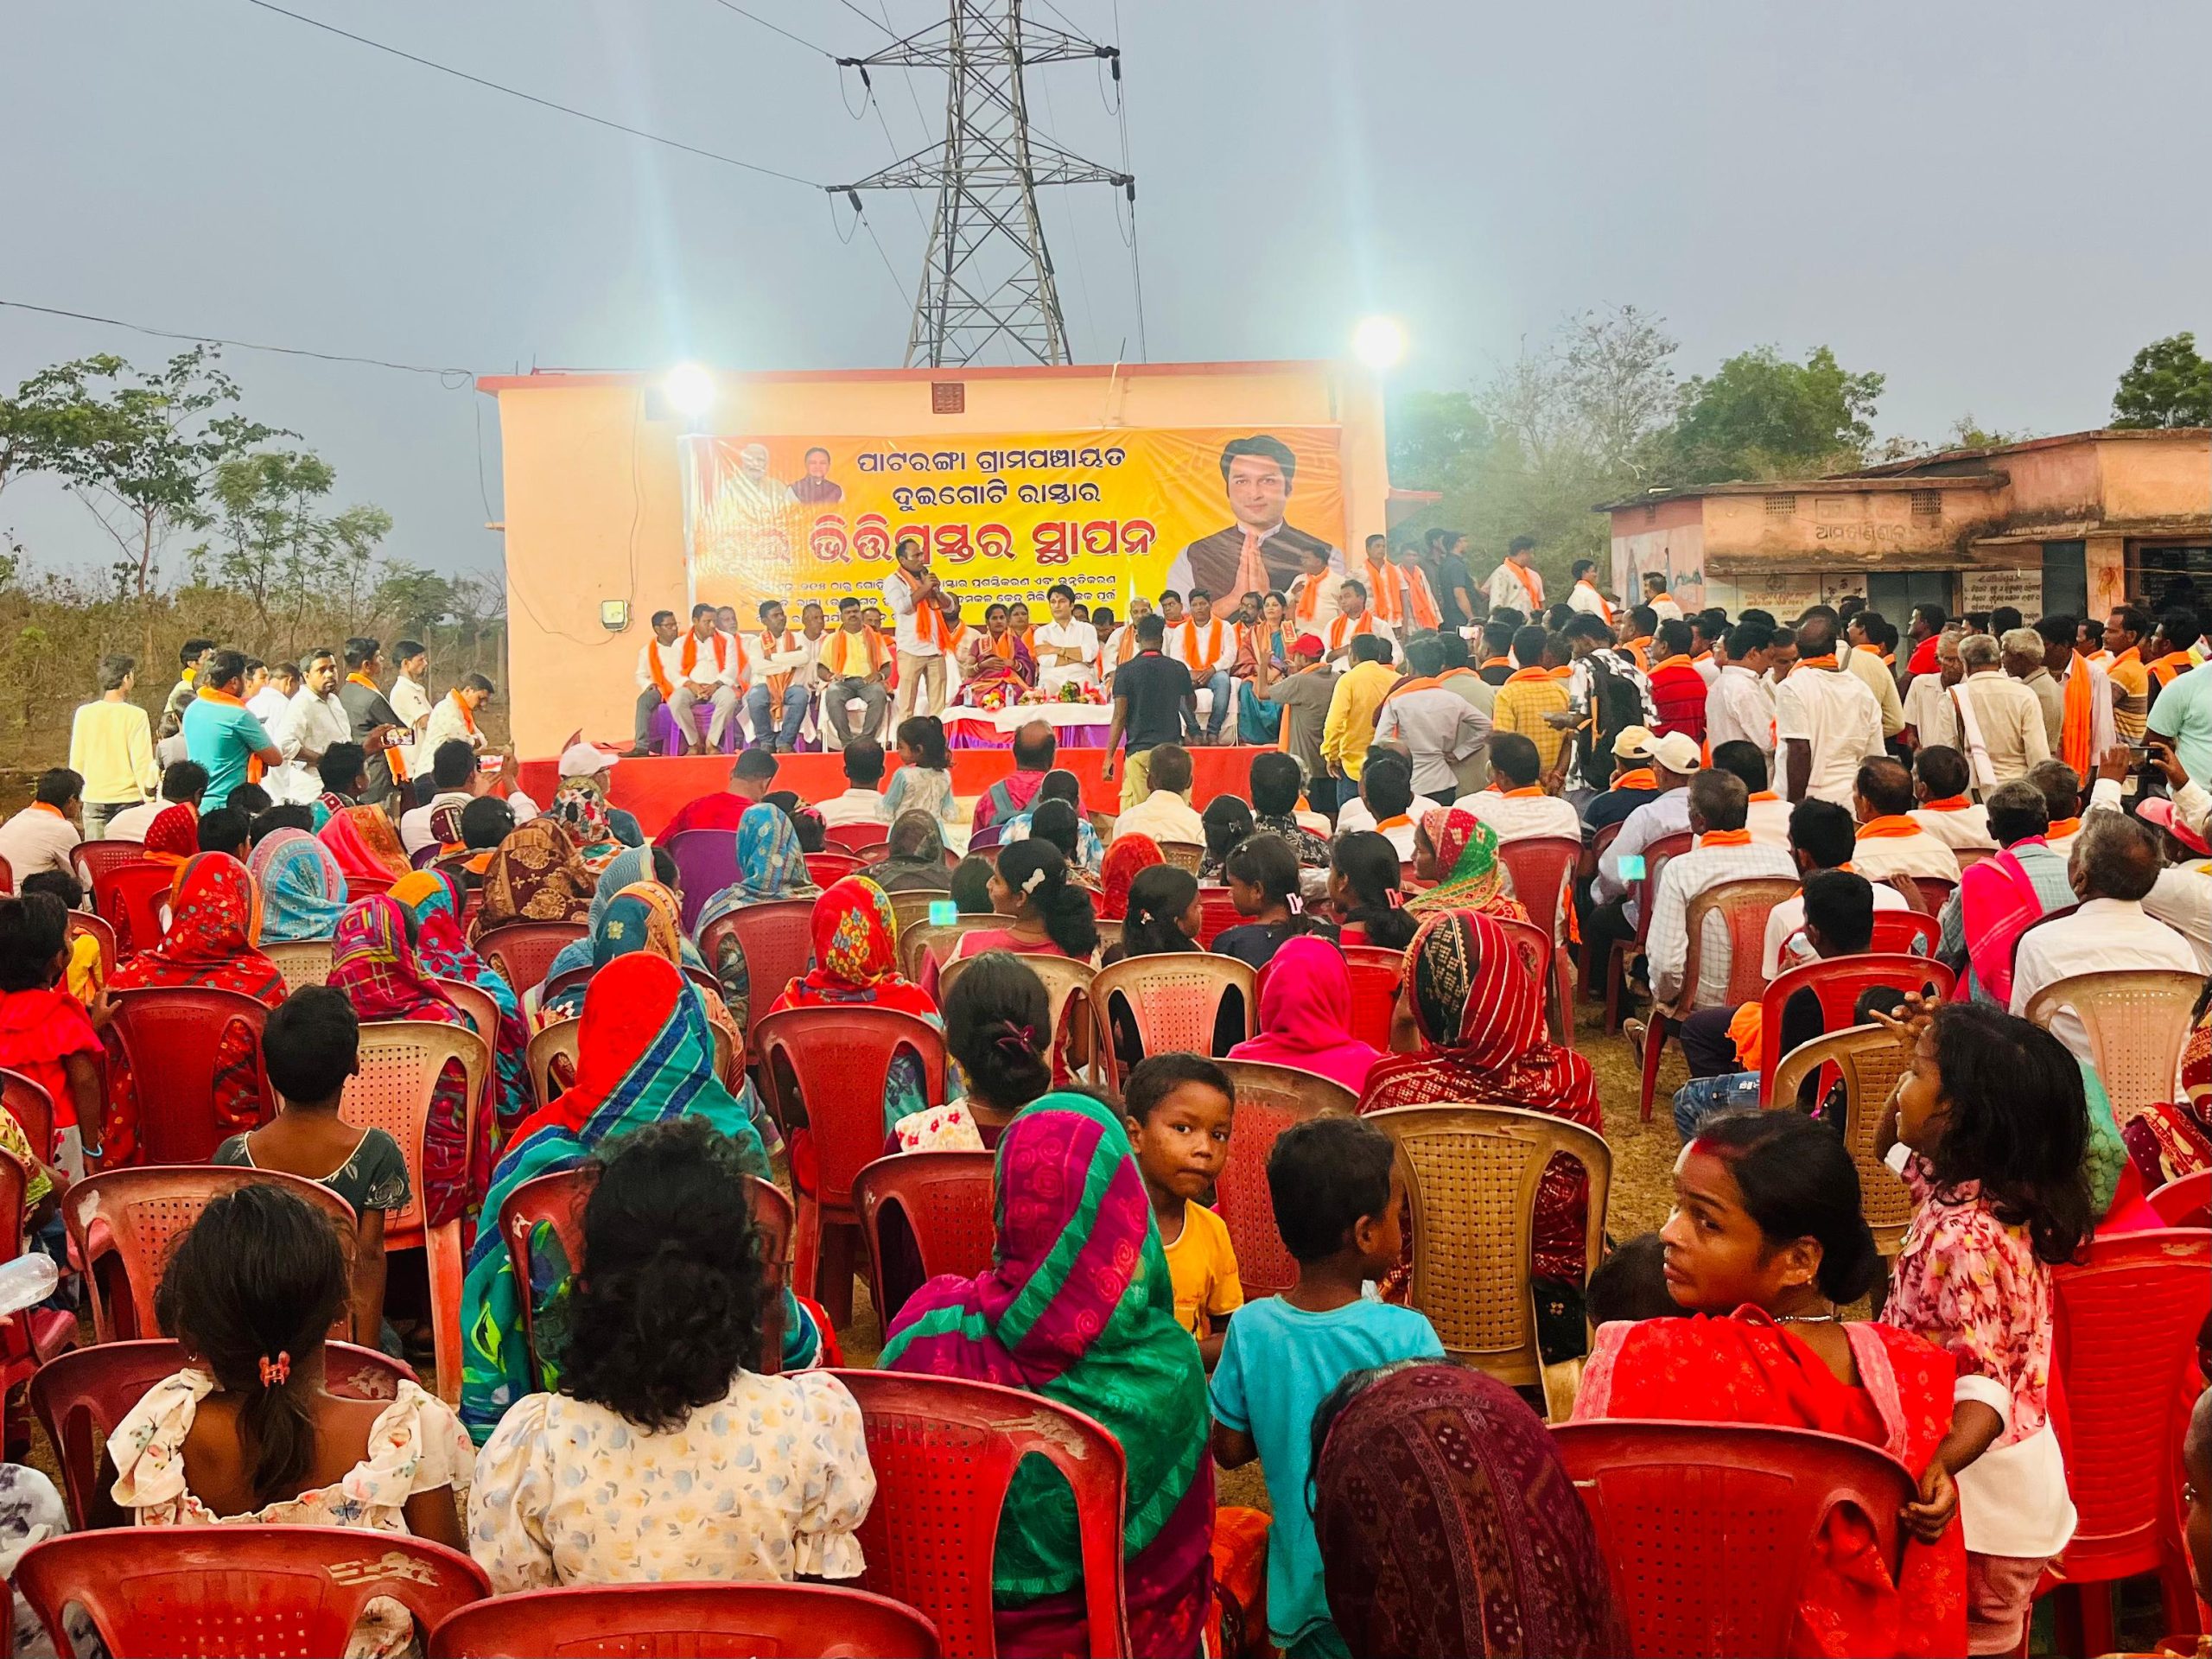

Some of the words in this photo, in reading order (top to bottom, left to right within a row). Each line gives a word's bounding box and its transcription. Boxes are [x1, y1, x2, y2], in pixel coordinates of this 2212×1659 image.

[857, 451, 966, 473] ପାଟରଙ୍ଗା
[976, 448, 1127, 474] ଗ୍ରାମପଞ୍ଚାୟତ
[892, 479, 1008, 512] ଦୁଇଗୋଟି
[1018, 483, 1102, 504] ରାସ୍ତାର
[1032, 518, 1157, 566] ସ୍ଥାପନ
[942, 580, 968, 588] ାସ୍ତାର
[1033, 576, 1055, 585] ଏବଂ
